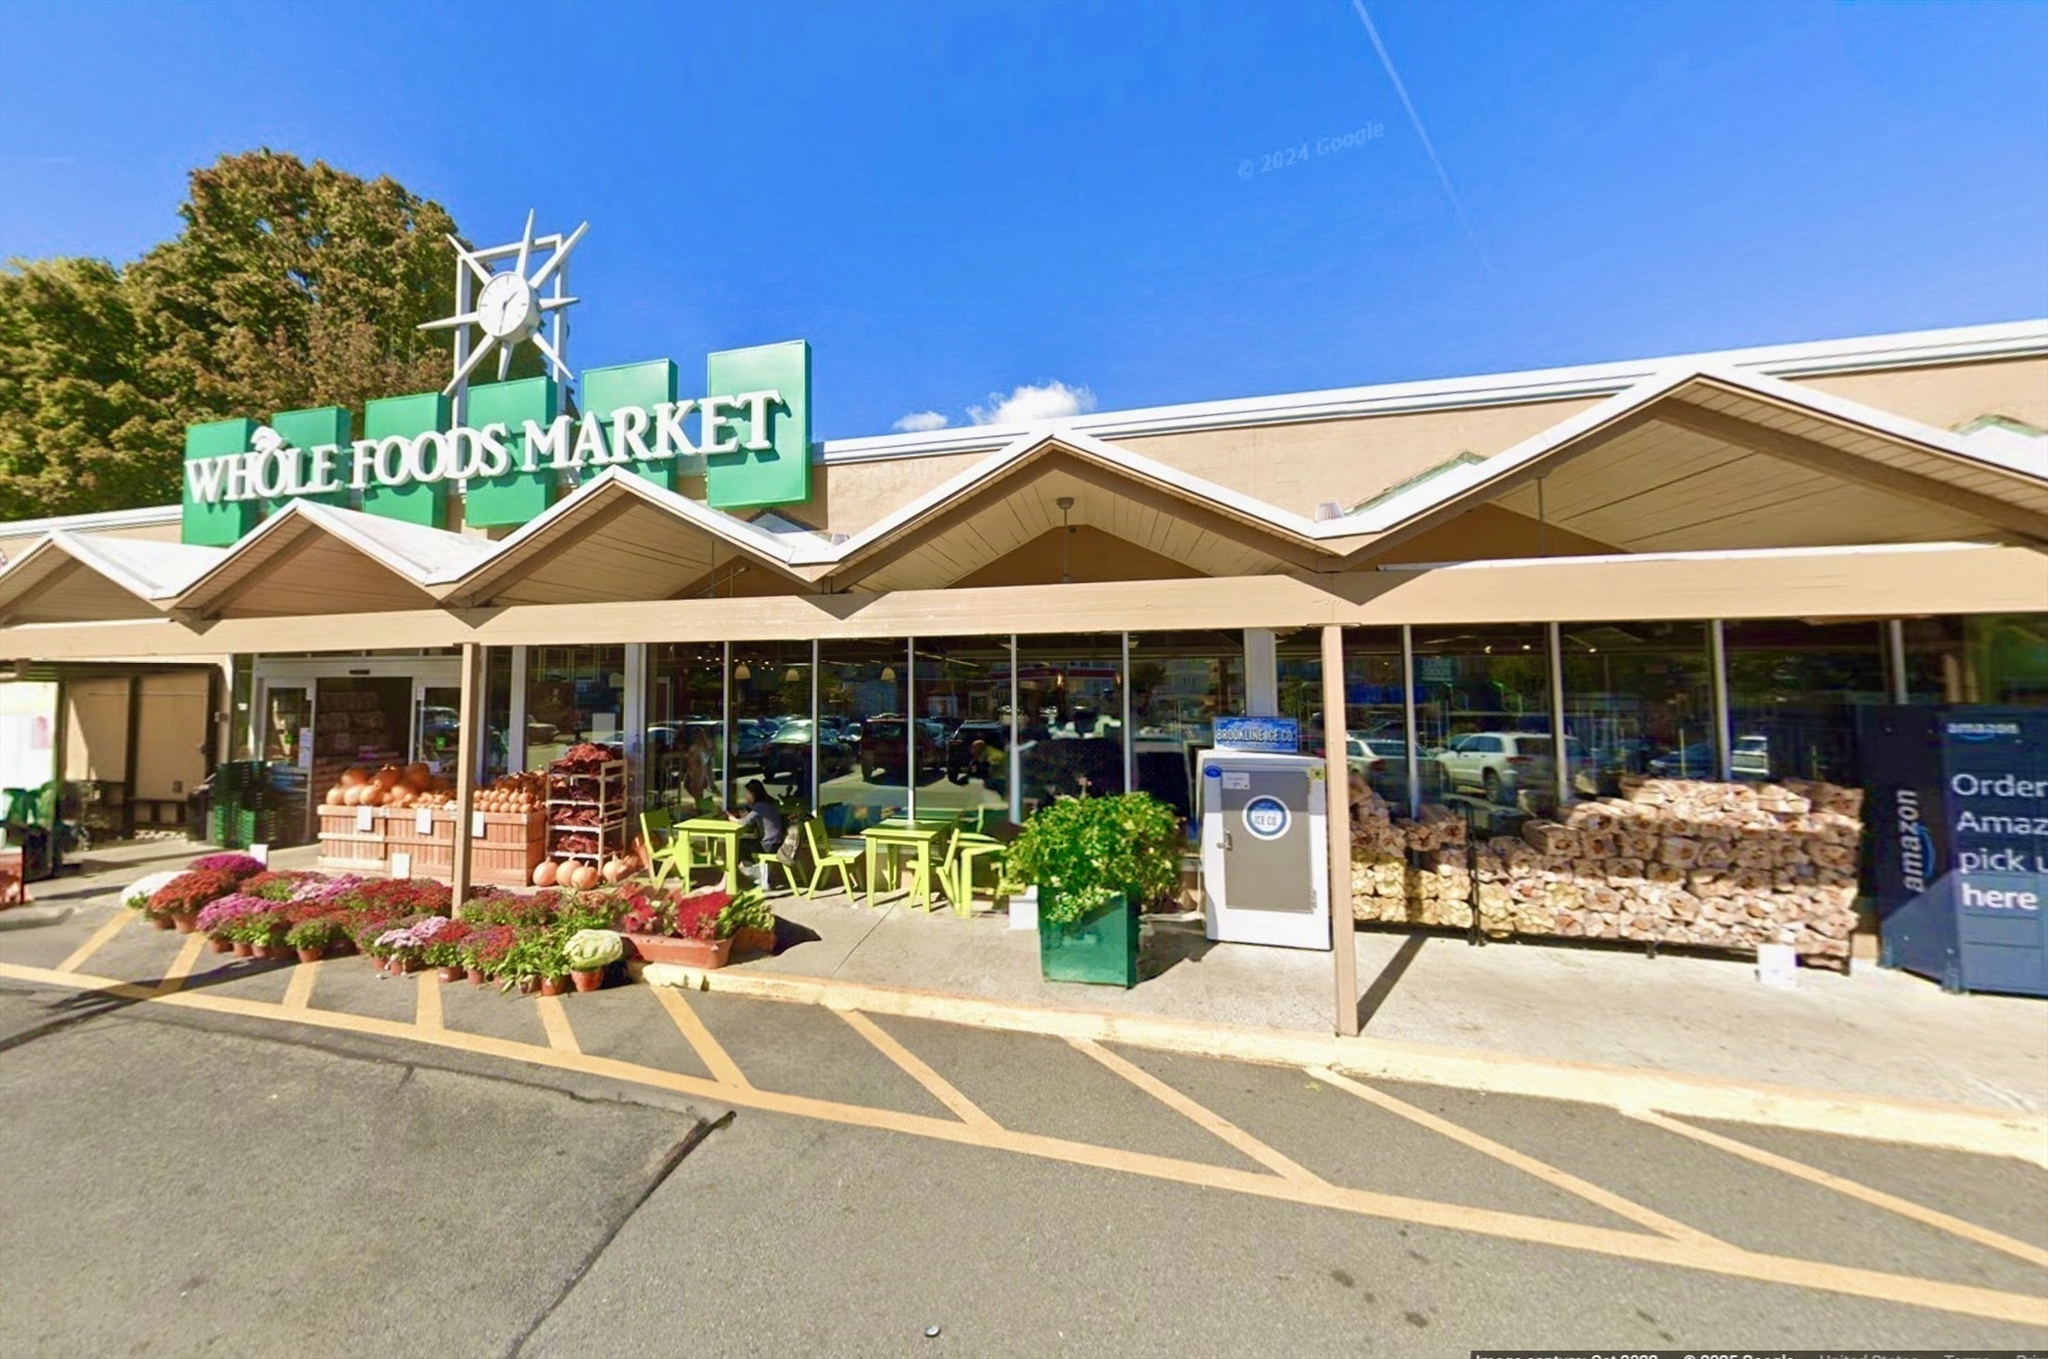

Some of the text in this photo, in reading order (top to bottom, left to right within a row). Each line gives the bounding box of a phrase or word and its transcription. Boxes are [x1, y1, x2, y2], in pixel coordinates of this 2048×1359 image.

[183, 389, 784, 504] WHOLE FOODS MARKET
[1216, 727, 1265, 742] BROOKLINE
[1266, 728, 1280, 742] ICE
[1951, 773, 2048, 797] Order
[1956, 811, 2048, 836] Amaz
[1896, 789, 1924, 893] amazon
[1959, 848, 2026, 876] pick
[1961, 882, 2040, 911] here
